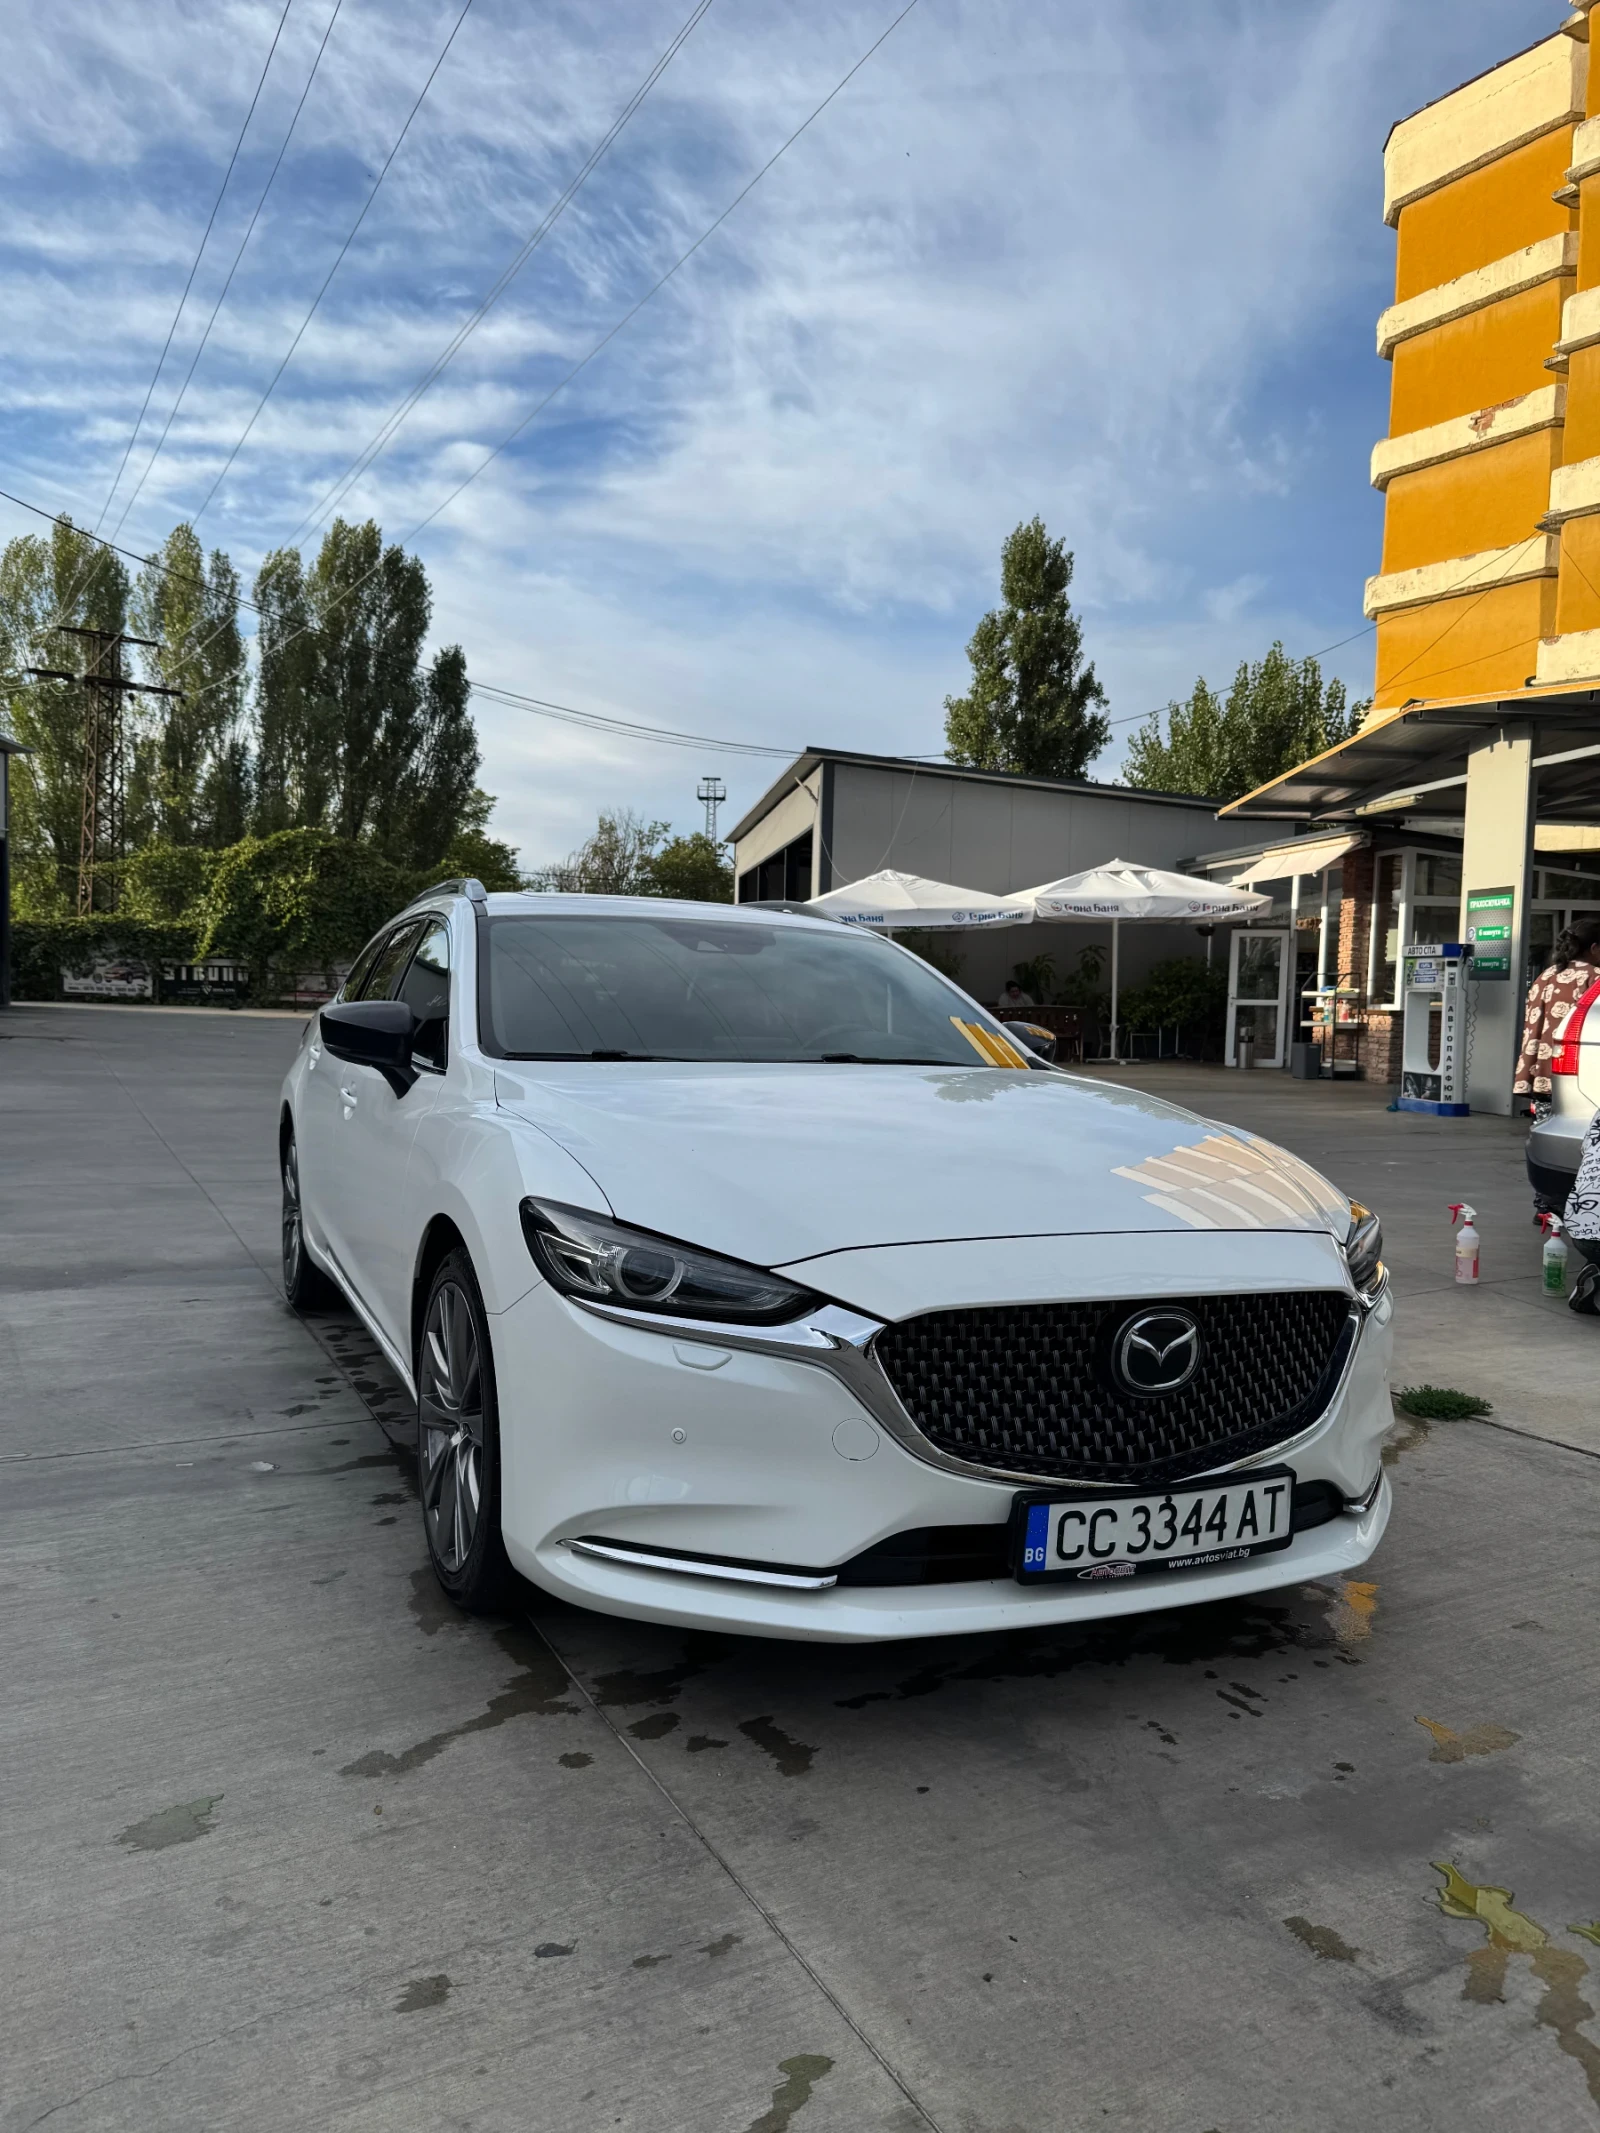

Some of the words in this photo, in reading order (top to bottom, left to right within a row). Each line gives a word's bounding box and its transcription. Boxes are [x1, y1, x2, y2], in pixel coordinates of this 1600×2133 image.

[1093, 902, 1119, 912] Баня
[858, 913, 885, 923] Баня
[1407, 946, 1423, 955] АВТО
[1423, 945, 1436, 955] СПА
[1444, 1005, 1454, 1101] АВТОПАРФЮМ
[1056, 1508, 1118, 1561] CC
[1126, 1494, 1228, 1555] 3344
[1235, 1484, 1285, 1539] AT
[1024, 1547, 1045, 1564] BG
[1168, 1548, 1250, 1568] www.avtosviat.bg
